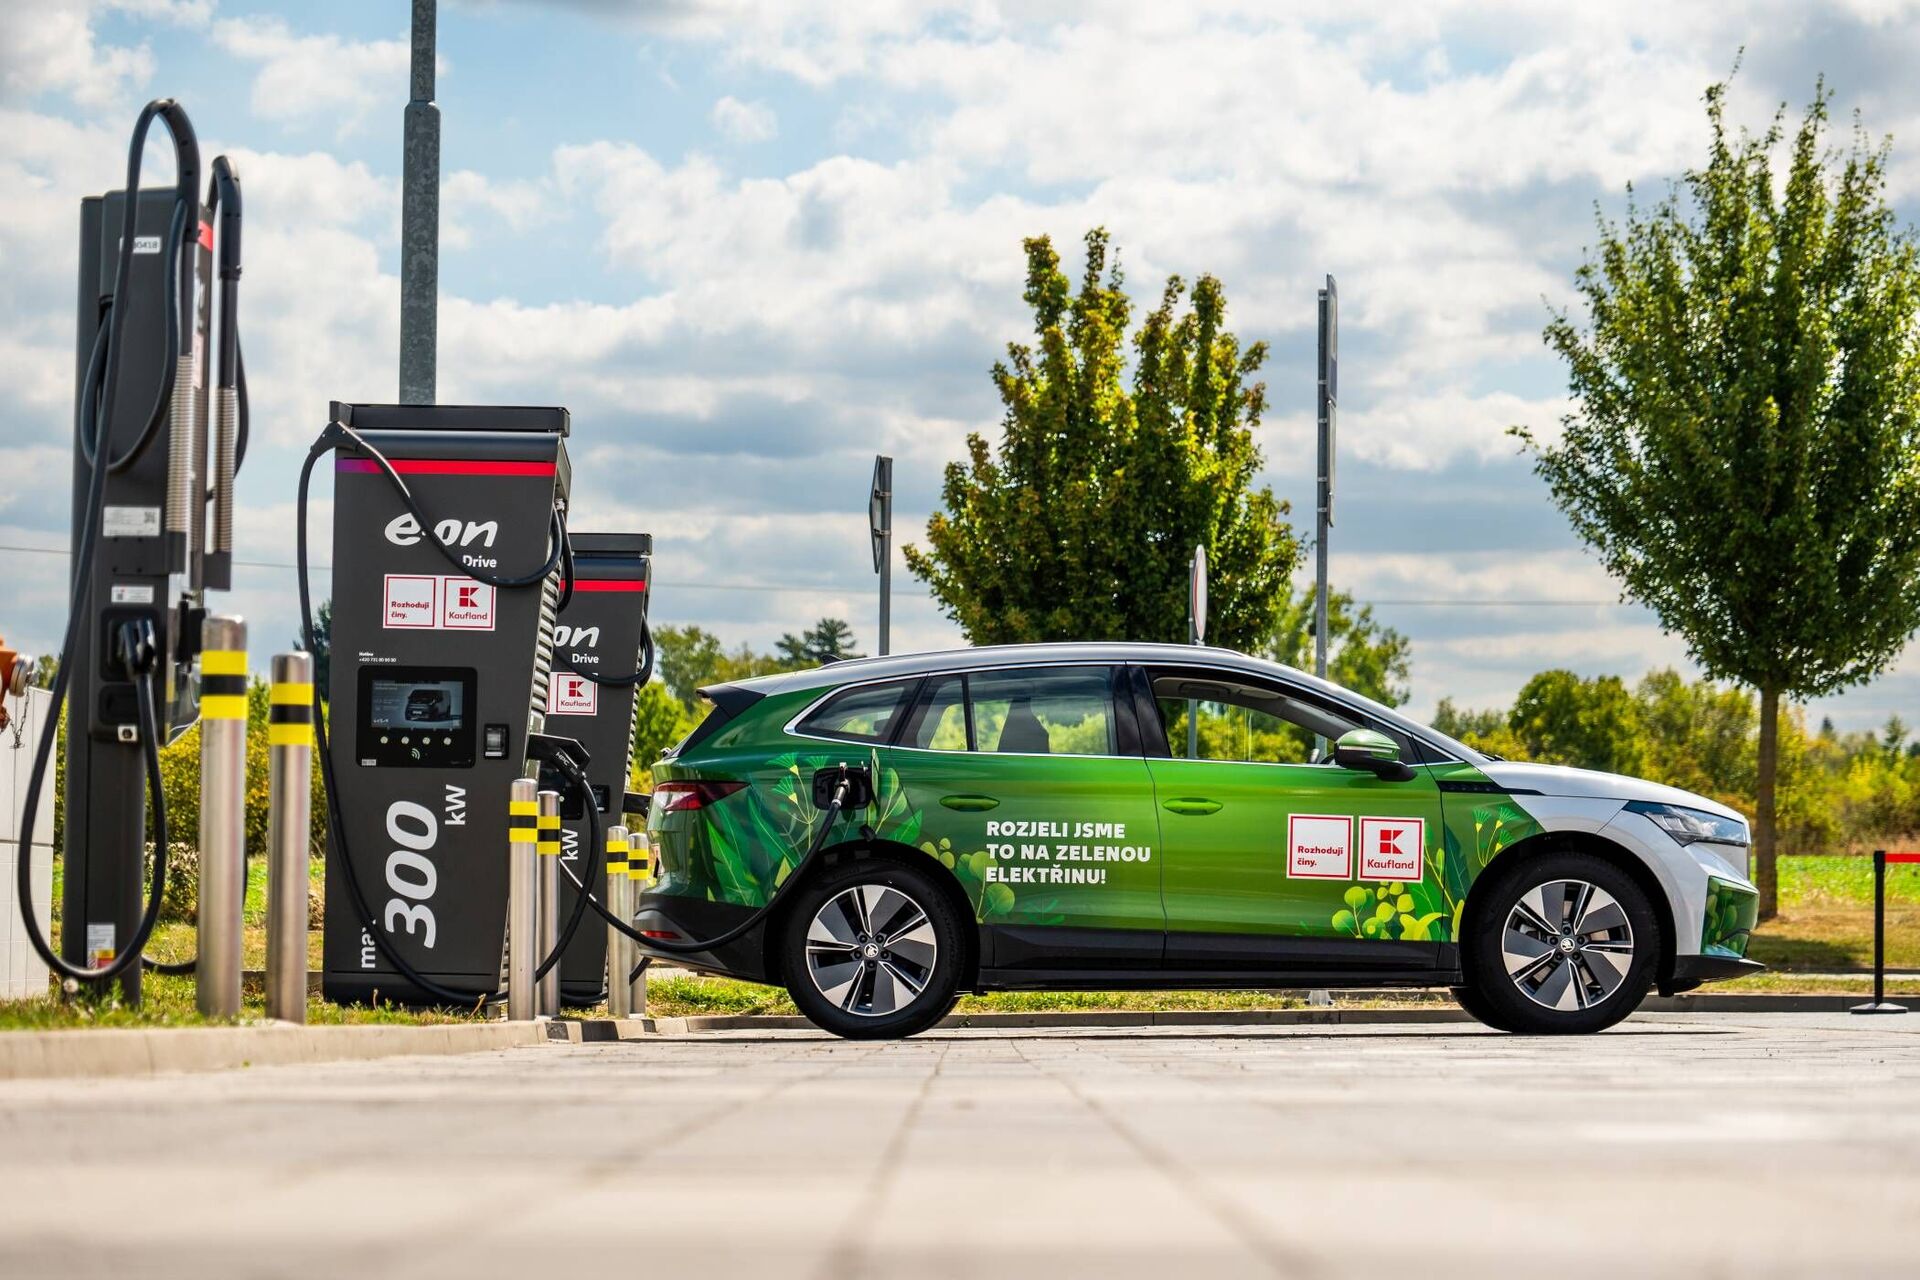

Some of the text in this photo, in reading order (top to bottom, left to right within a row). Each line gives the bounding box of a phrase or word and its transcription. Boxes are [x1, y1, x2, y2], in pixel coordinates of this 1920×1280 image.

[462, 554, 498, 568] Drive
[448, 611, 488, 620] Kaufland
[571, 653, 600, 664] Drive
[560, 699, 592, 707] Kaufland
[444, 784, 466, 826] kW
[986, 820, 1126, 839] ROZJELI JSME
[561, 828, 579, 860] kW
[1297, 845, 1344, 857] Rozhodují
[986, 843, 1151, 863] TO NA ZELENOU
[1297, 856, 1317, 868] činy.
[1367, 859, 1414, 870] Kaufland
[384, 800, 438, 949] 300
[985, 863, 1106, 885] ELEKTŘINU!
[361, 919, 377, 969] ma
